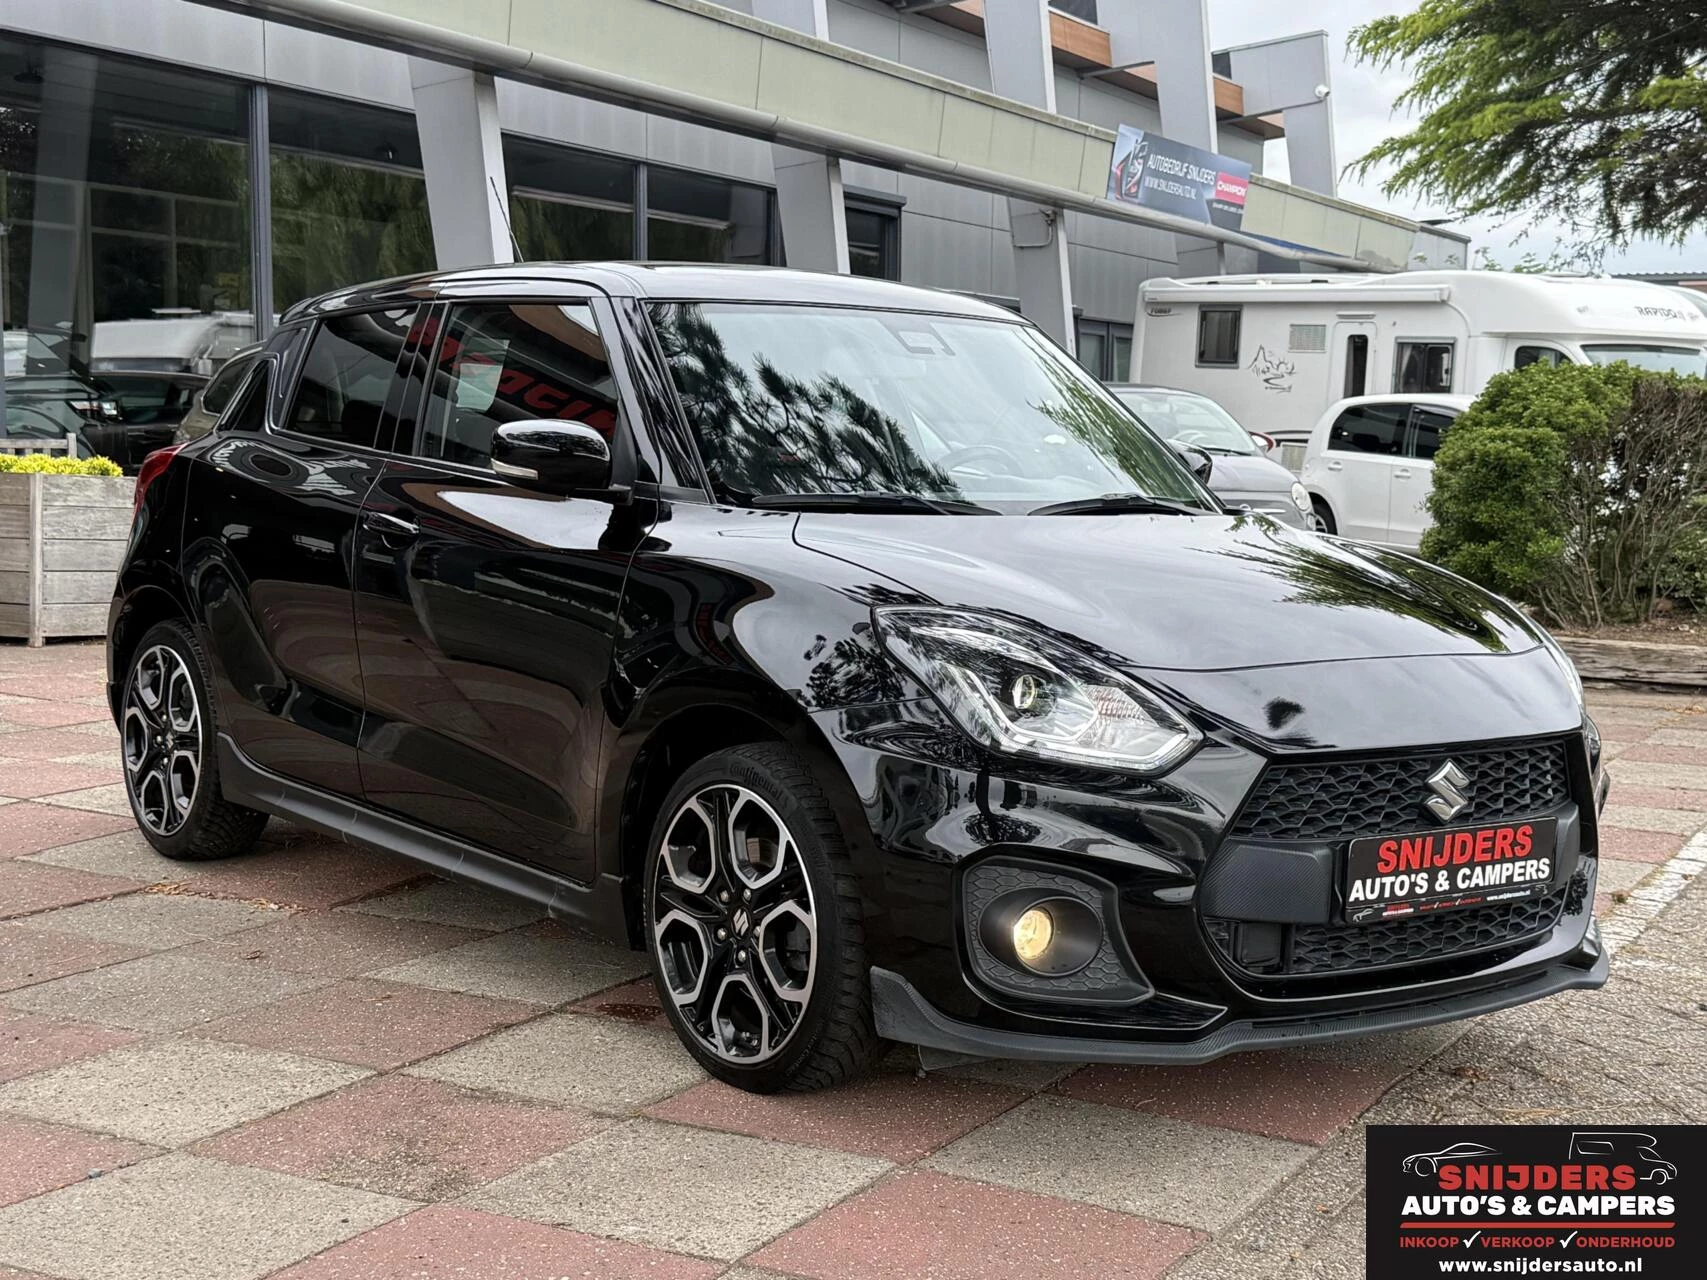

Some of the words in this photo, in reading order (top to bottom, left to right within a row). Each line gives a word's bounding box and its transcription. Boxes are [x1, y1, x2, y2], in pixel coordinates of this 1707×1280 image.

[1147, 154, 1187, 176] AUTOBEDRIJF
[1188, 165, 1216, 185] SNIJDERS
[1217, 181, 1247, 196] CHAMPION
[1377, 825, 1534, 874] SNIJDERS
[1349, 872, 1429, 902] AUTO'S
[1434, 869, 1450, 892] &
[1456, 857, 1550, 889] CAMPERS
